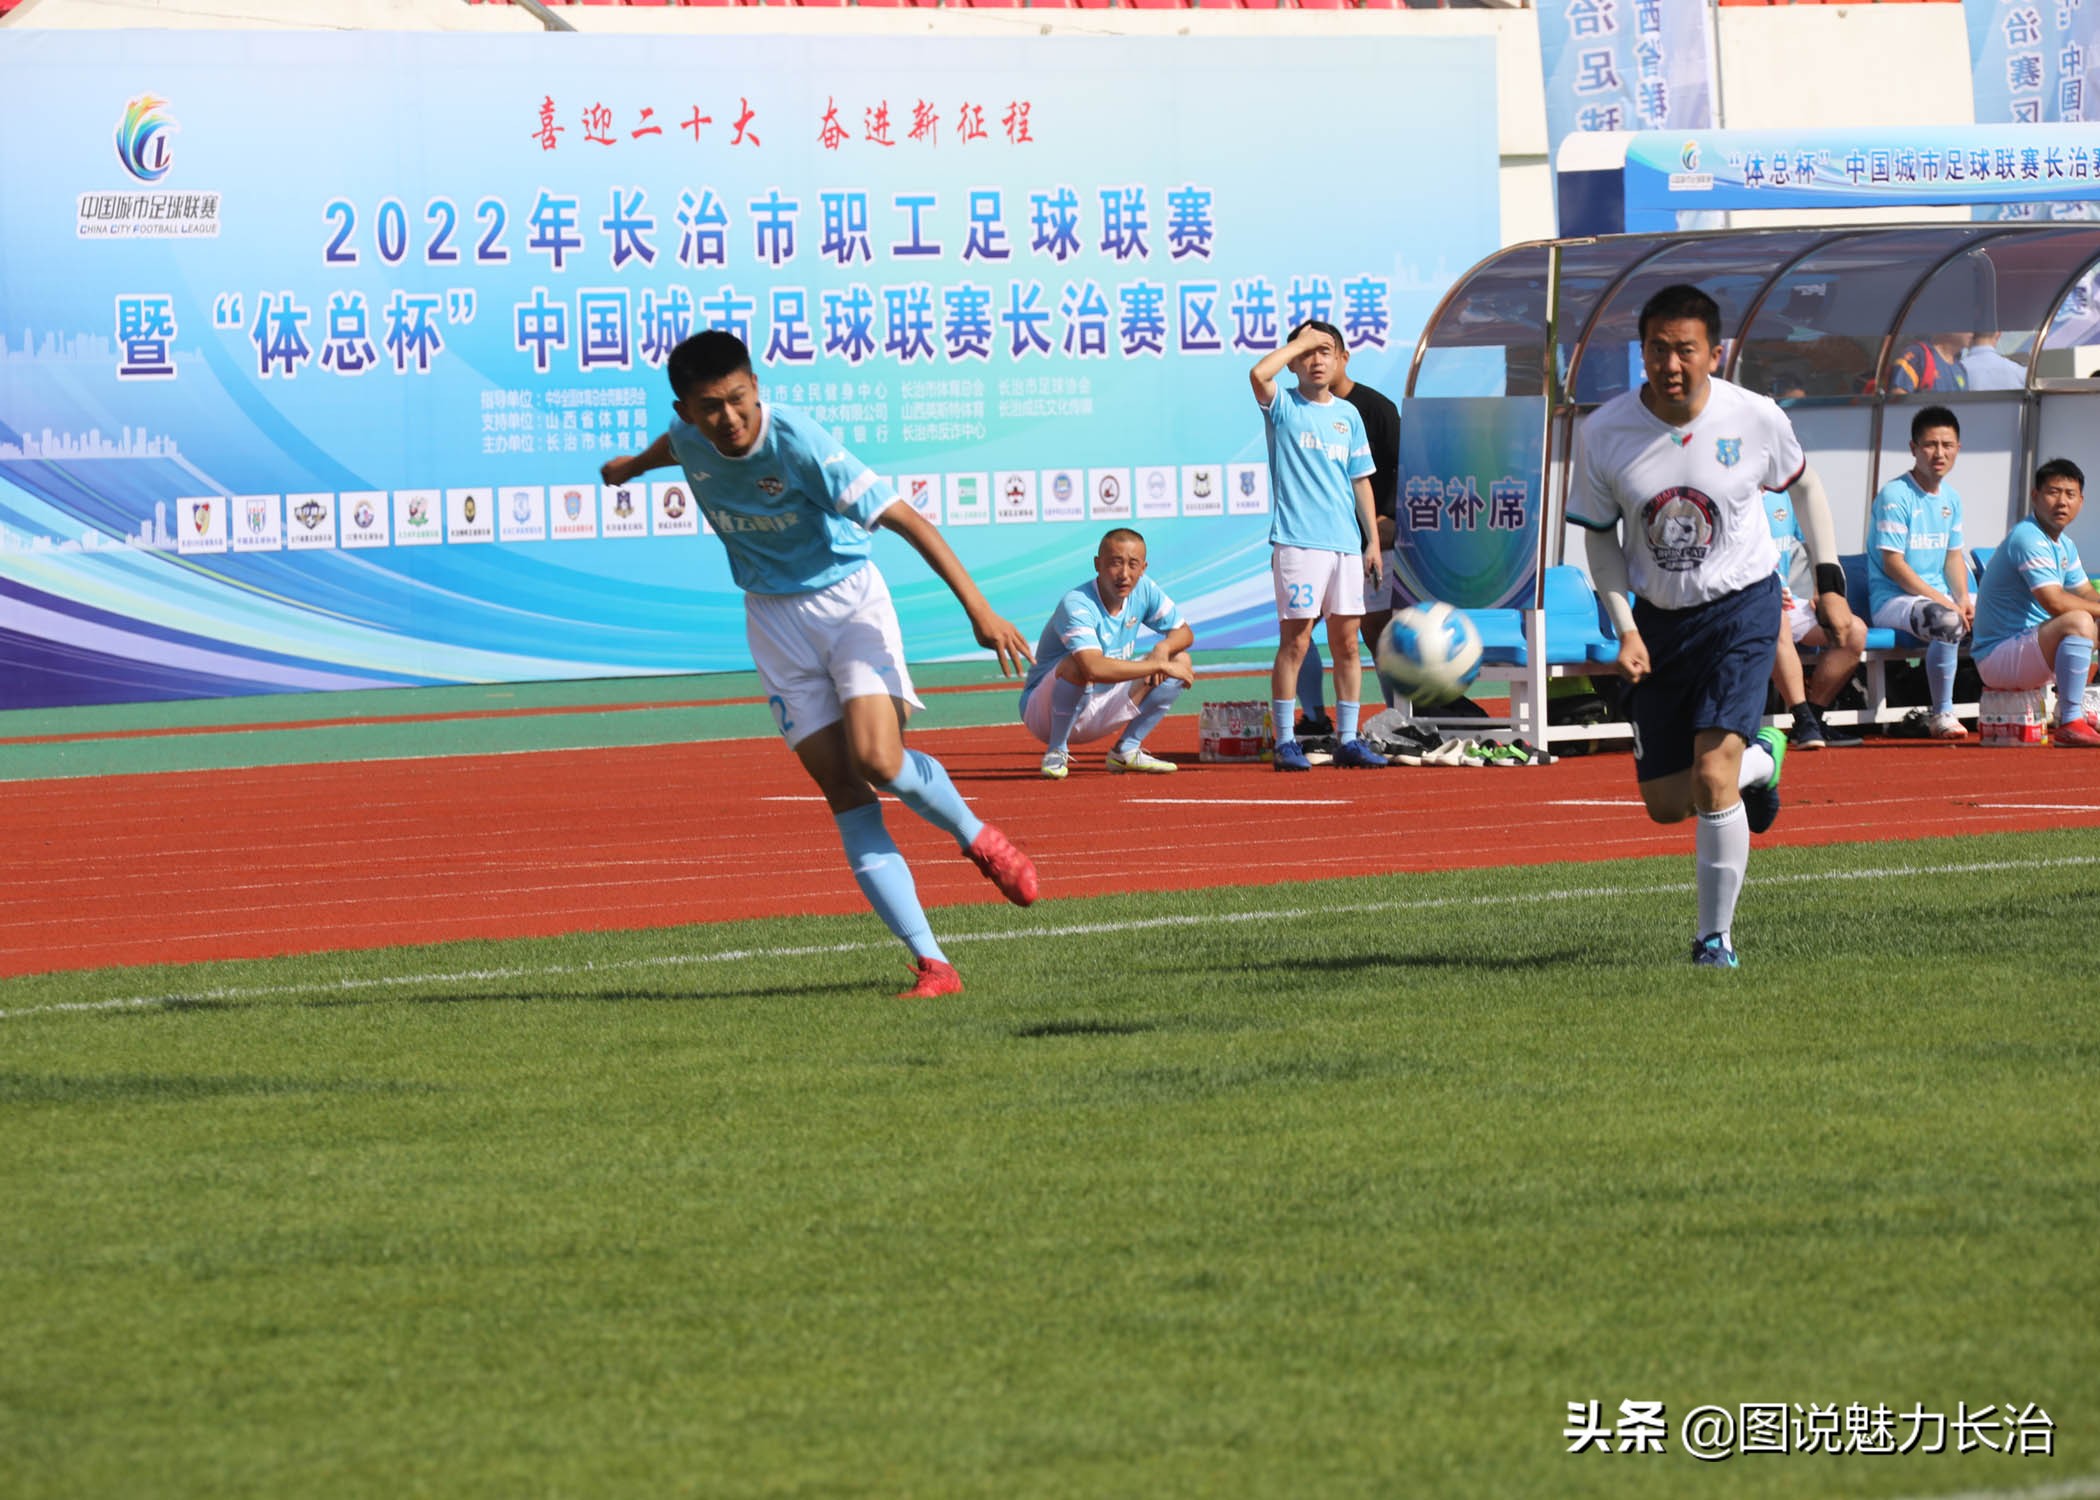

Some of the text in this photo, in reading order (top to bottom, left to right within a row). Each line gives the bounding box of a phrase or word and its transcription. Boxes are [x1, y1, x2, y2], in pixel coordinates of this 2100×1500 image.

[532, 95, 1034, 151] 喜迎二十大 奋进新征程
[1730, 151, 1830, 187] “体总杯”
[79, 223, 217, 235] CHINA CITY FOOTBALL LEAGUE
[80, 195, 219, 221] 中国城市足球联赛
[325, 186, 1213, 269] 2022年长治市职工足球联赛
[118, 277, 1389, 375] 暨 “体总杯” 中国城市足球联赛长治赛区选拔赛
[1407, 478, 1526, 530] 替补席
[1287, 583, 1314, 609] 23
